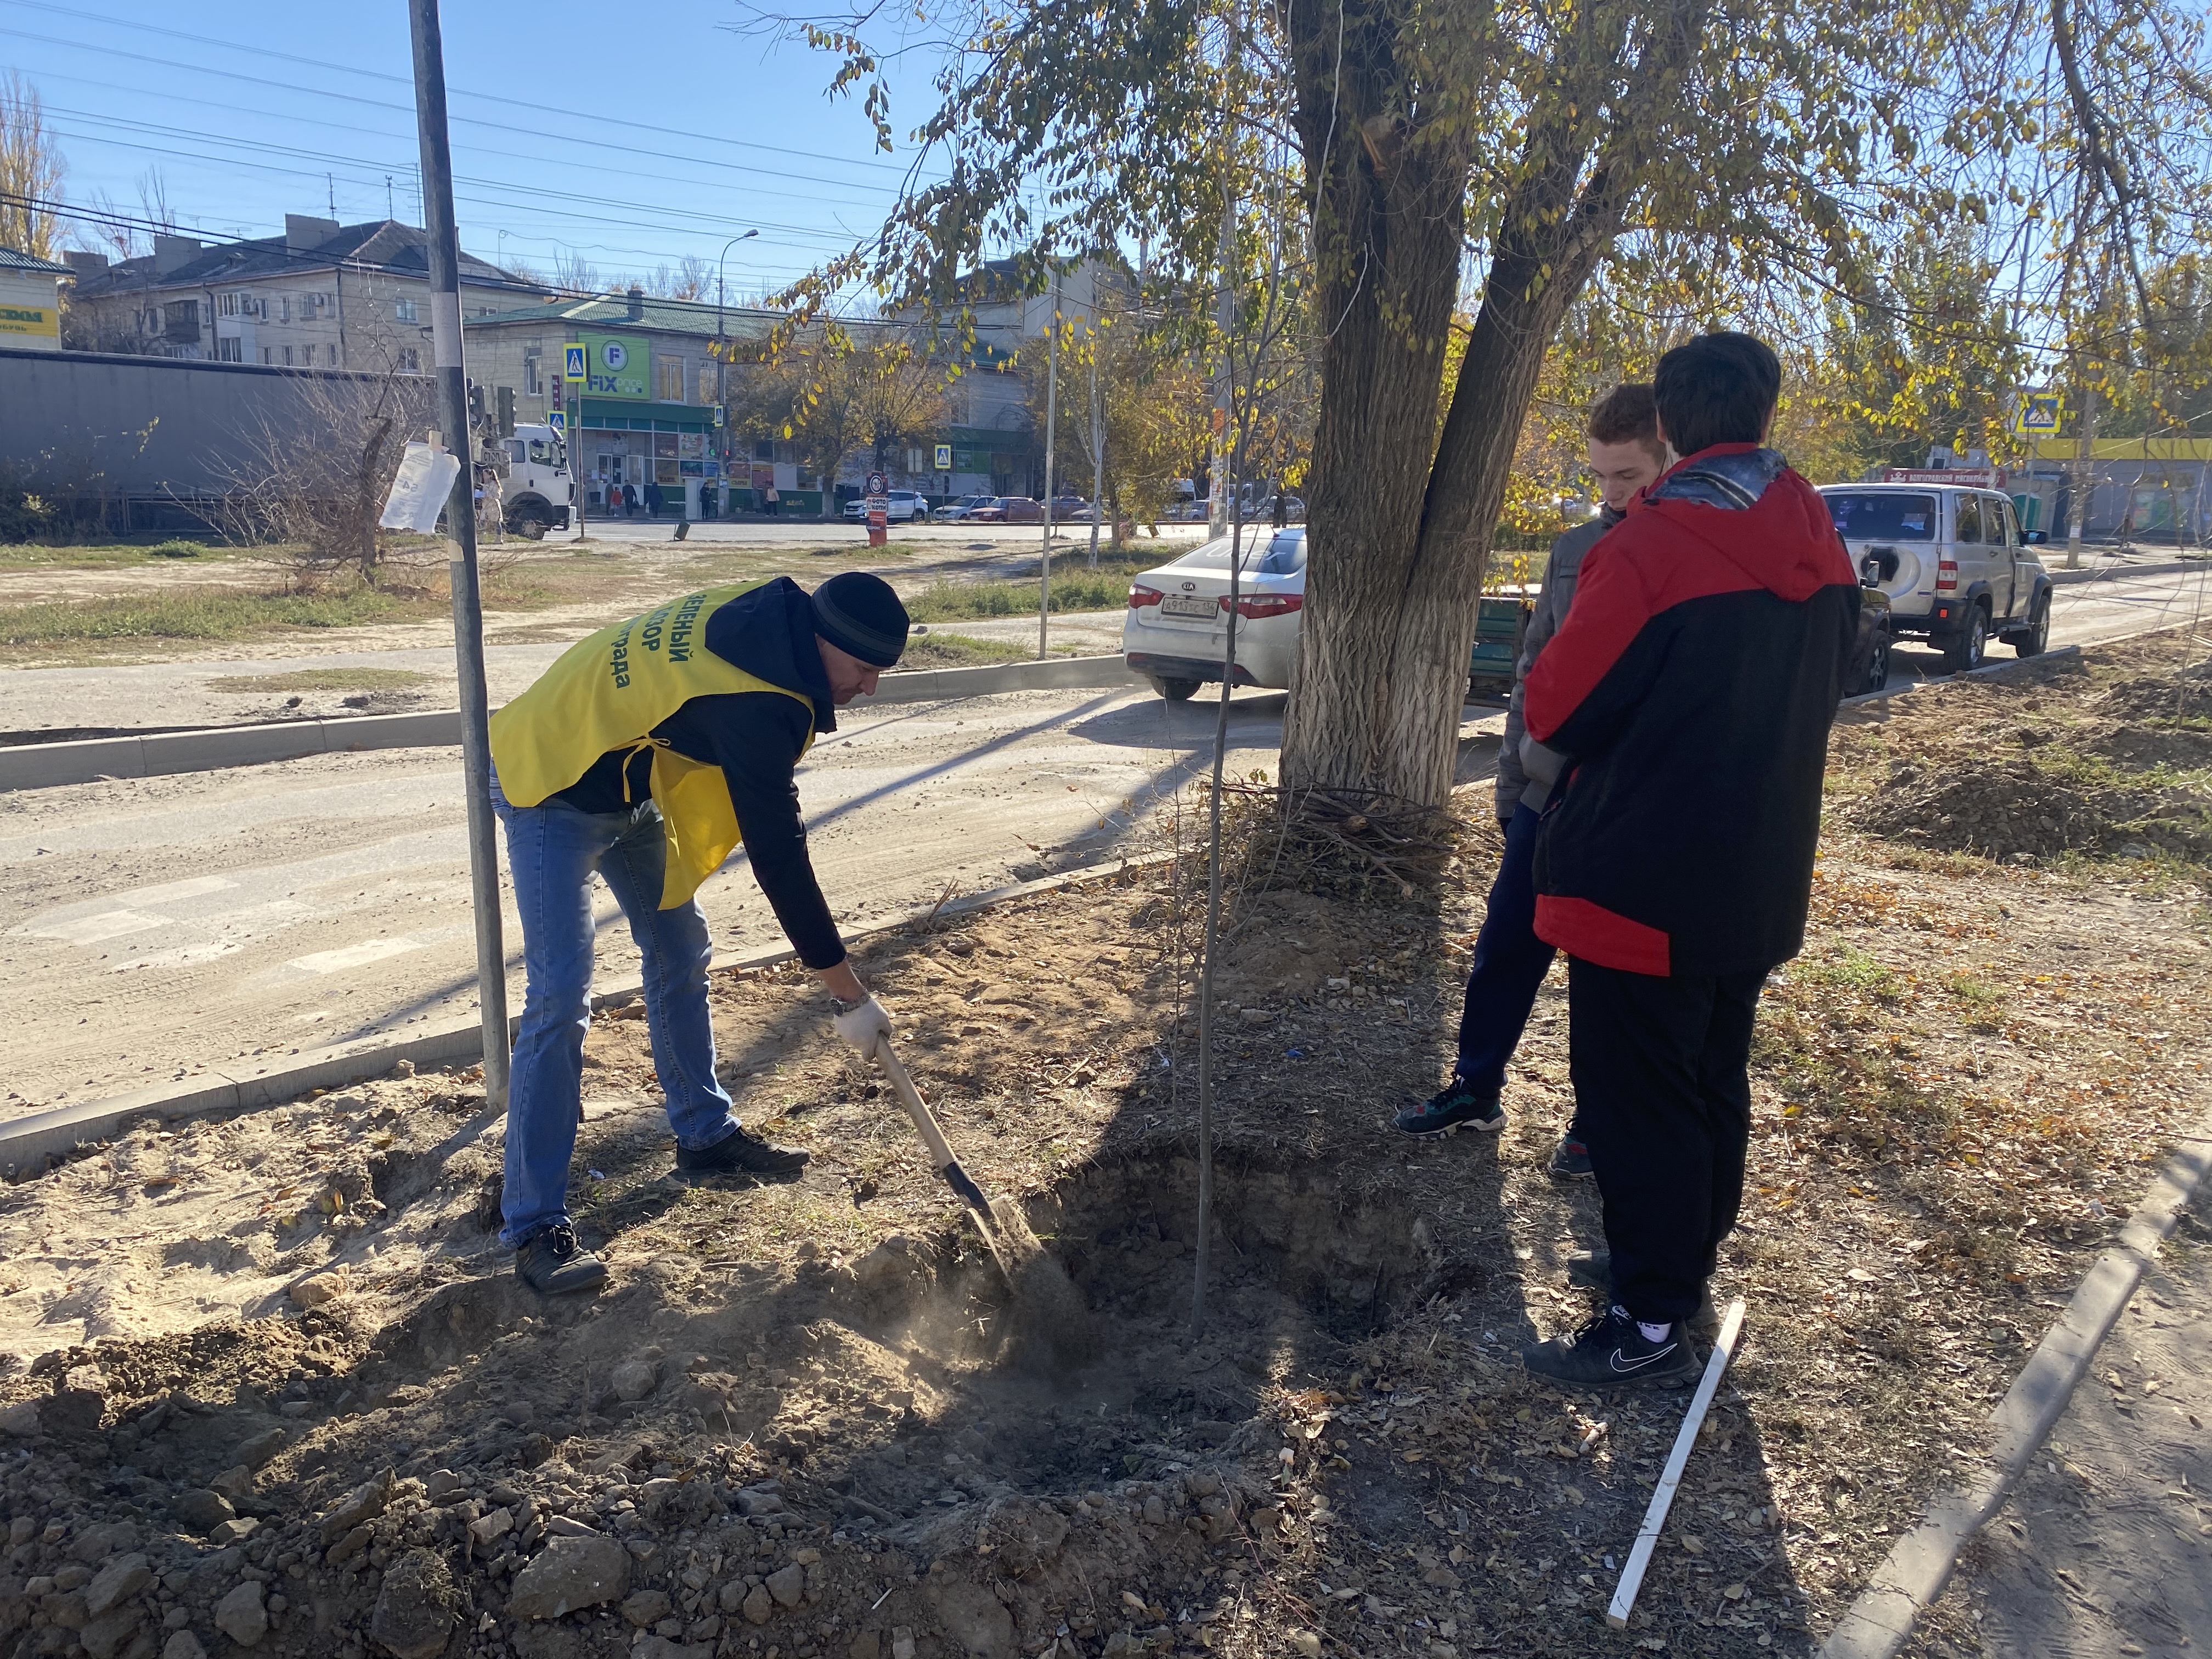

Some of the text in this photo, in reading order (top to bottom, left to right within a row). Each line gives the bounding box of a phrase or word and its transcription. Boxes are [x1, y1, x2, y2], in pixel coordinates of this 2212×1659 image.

[609, 347, 620, 364] F
[617, 378, 642, 387] price
[1206, 546, 1286, 561] Uber
[669, 594, 707, 663] ЗЕЛЕНЫЙ
